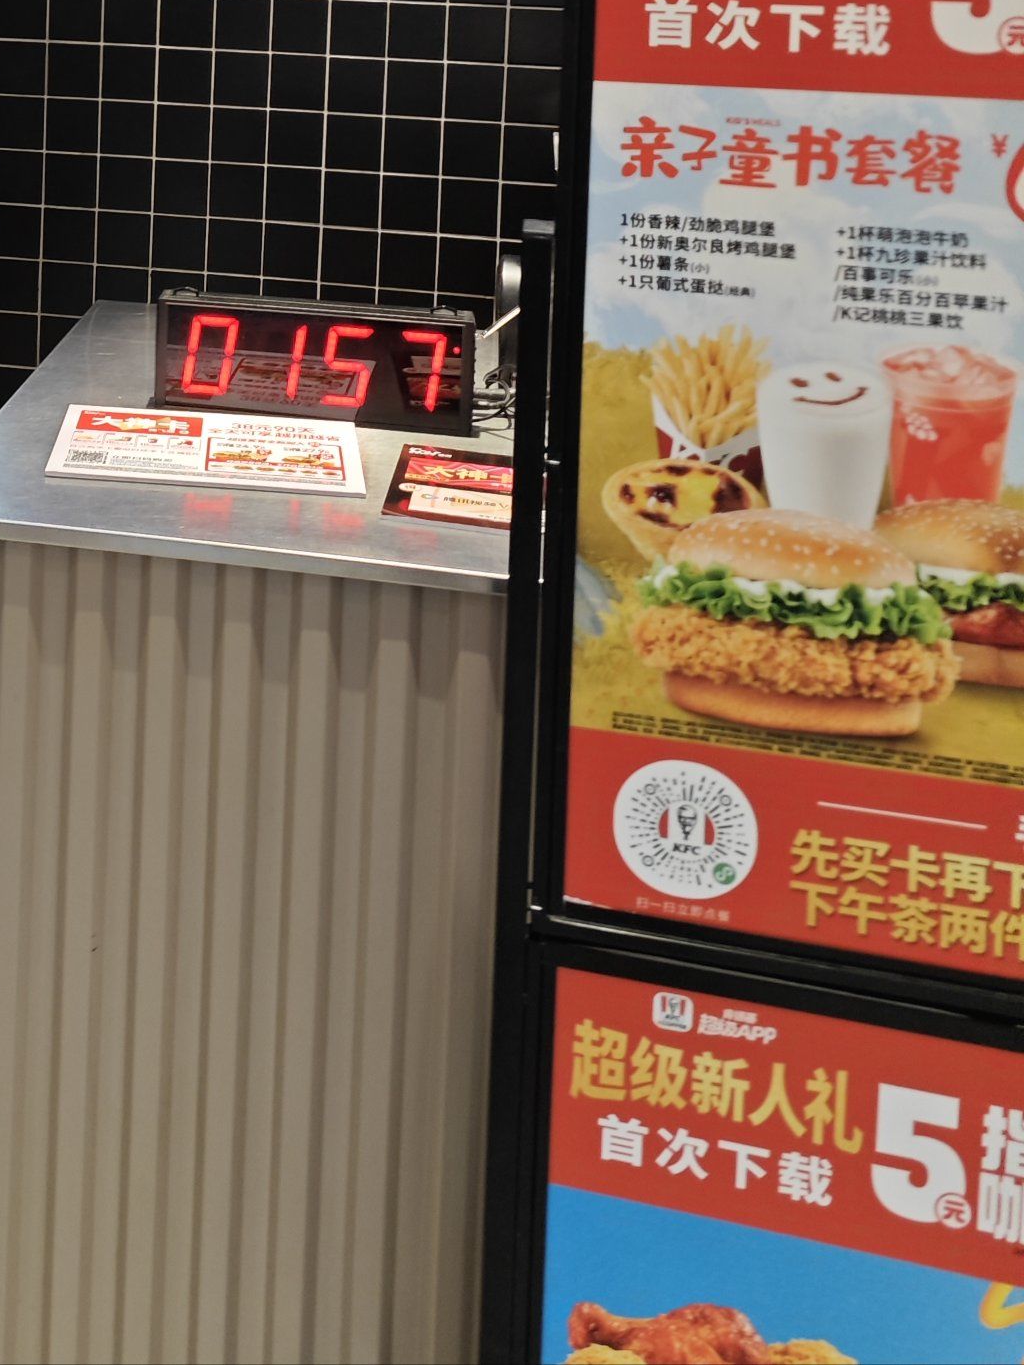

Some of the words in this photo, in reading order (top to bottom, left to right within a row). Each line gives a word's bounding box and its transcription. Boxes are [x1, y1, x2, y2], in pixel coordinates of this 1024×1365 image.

[620, 115, 962, 194] 亲子童书套餐
[620, 212, 775, 237] 1份香辣/劲脆鸡腿堡
[620, 234, 796, 259] +1份新奥尔良烤鸡腿堡
[673, 842, 701, 857] KFC
[569, 1020, 863, 1154] 超级新人礼
[871, 1083, 967, 1224] 5
[598, 1114, 833, 1207] 首次下载
